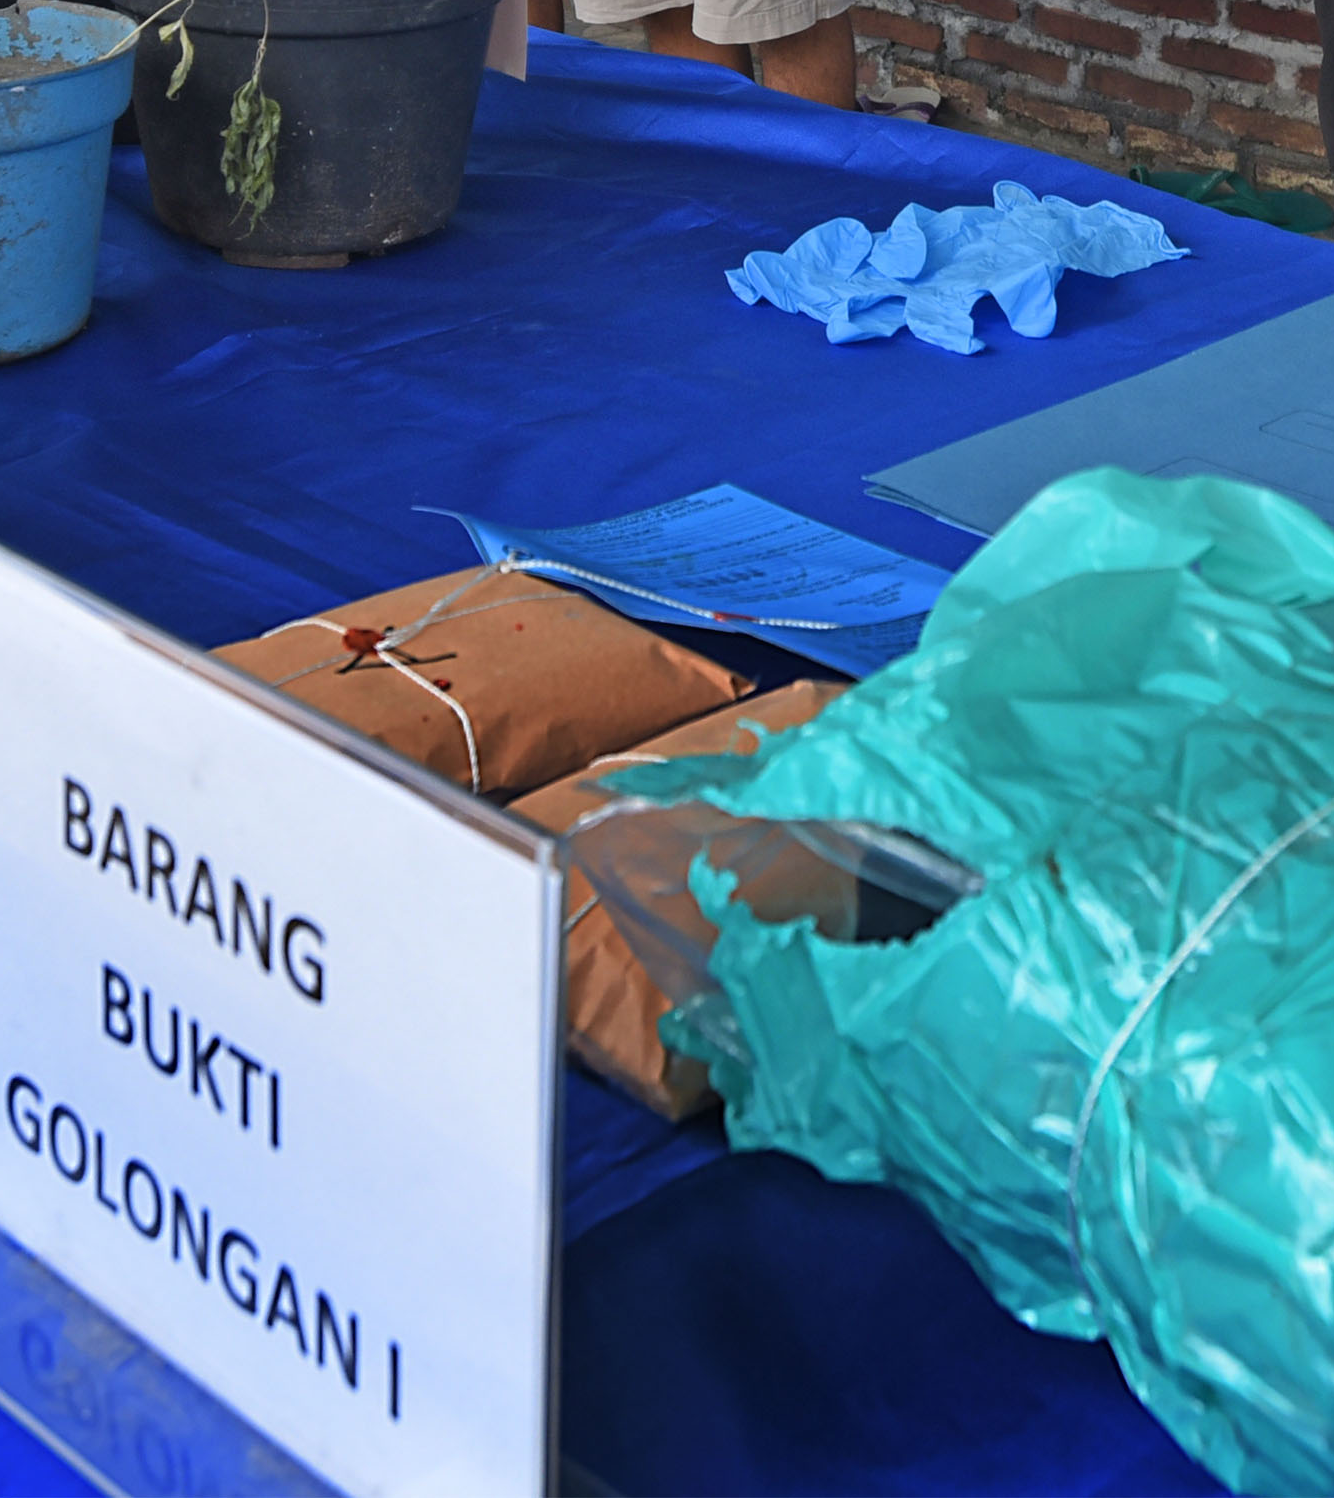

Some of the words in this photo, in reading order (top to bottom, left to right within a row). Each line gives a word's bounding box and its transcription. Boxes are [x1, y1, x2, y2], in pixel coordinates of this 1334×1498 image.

[62, 775, 326, 1005] BARANG
[101, 963, 281, 1150] BUKTI
[5, 1075, 360, 1392] GOLONGAN
[387, 1340, 401, 1422] I
